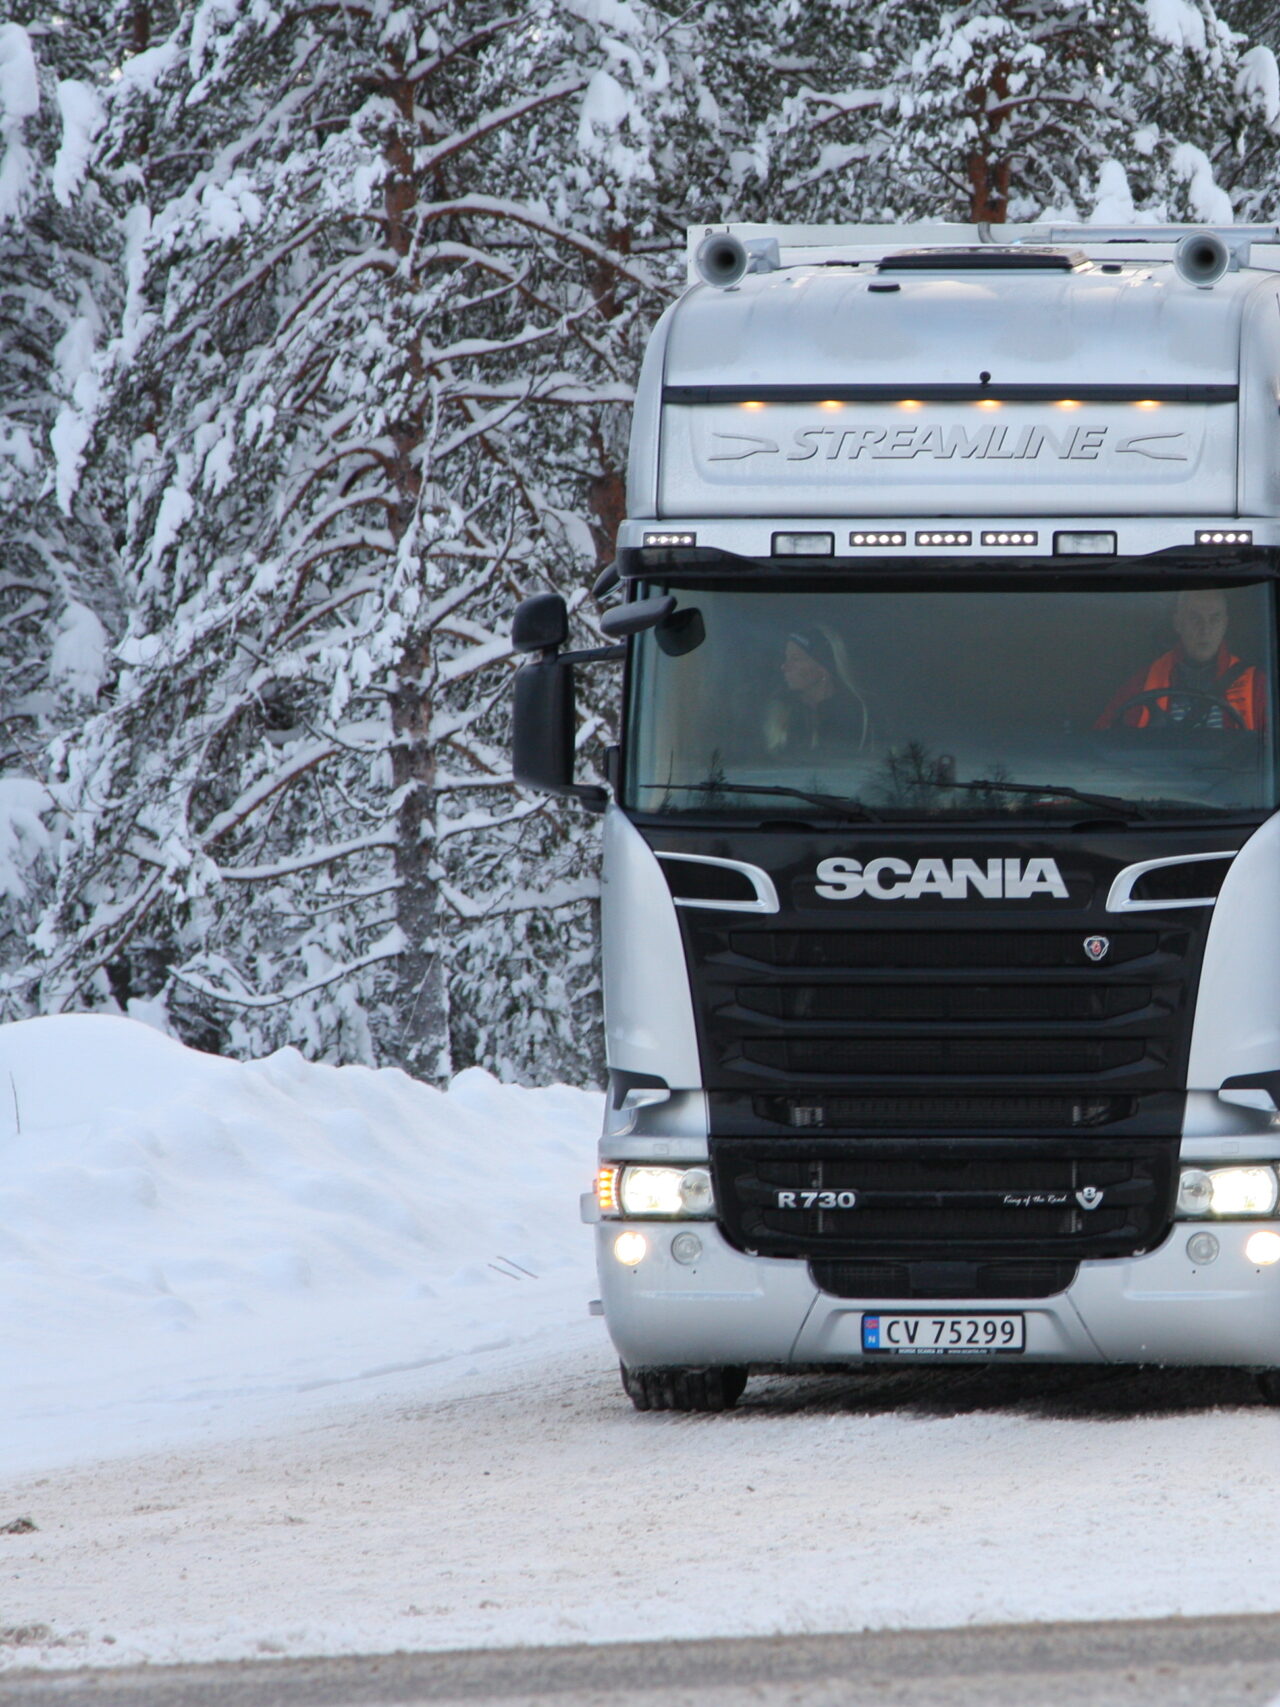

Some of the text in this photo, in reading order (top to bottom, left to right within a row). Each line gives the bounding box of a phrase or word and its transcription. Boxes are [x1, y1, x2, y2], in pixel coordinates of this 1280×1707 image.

[788, 424, 1109, 461] STREAMLINE
[815, 857, 1069, 900] SCANIA
[778, 1191, 856, 1208] R 730
[1003, 1194, 1067, 1207] King of the Road
[886, 1320, 1015, 1345] CV 75299
